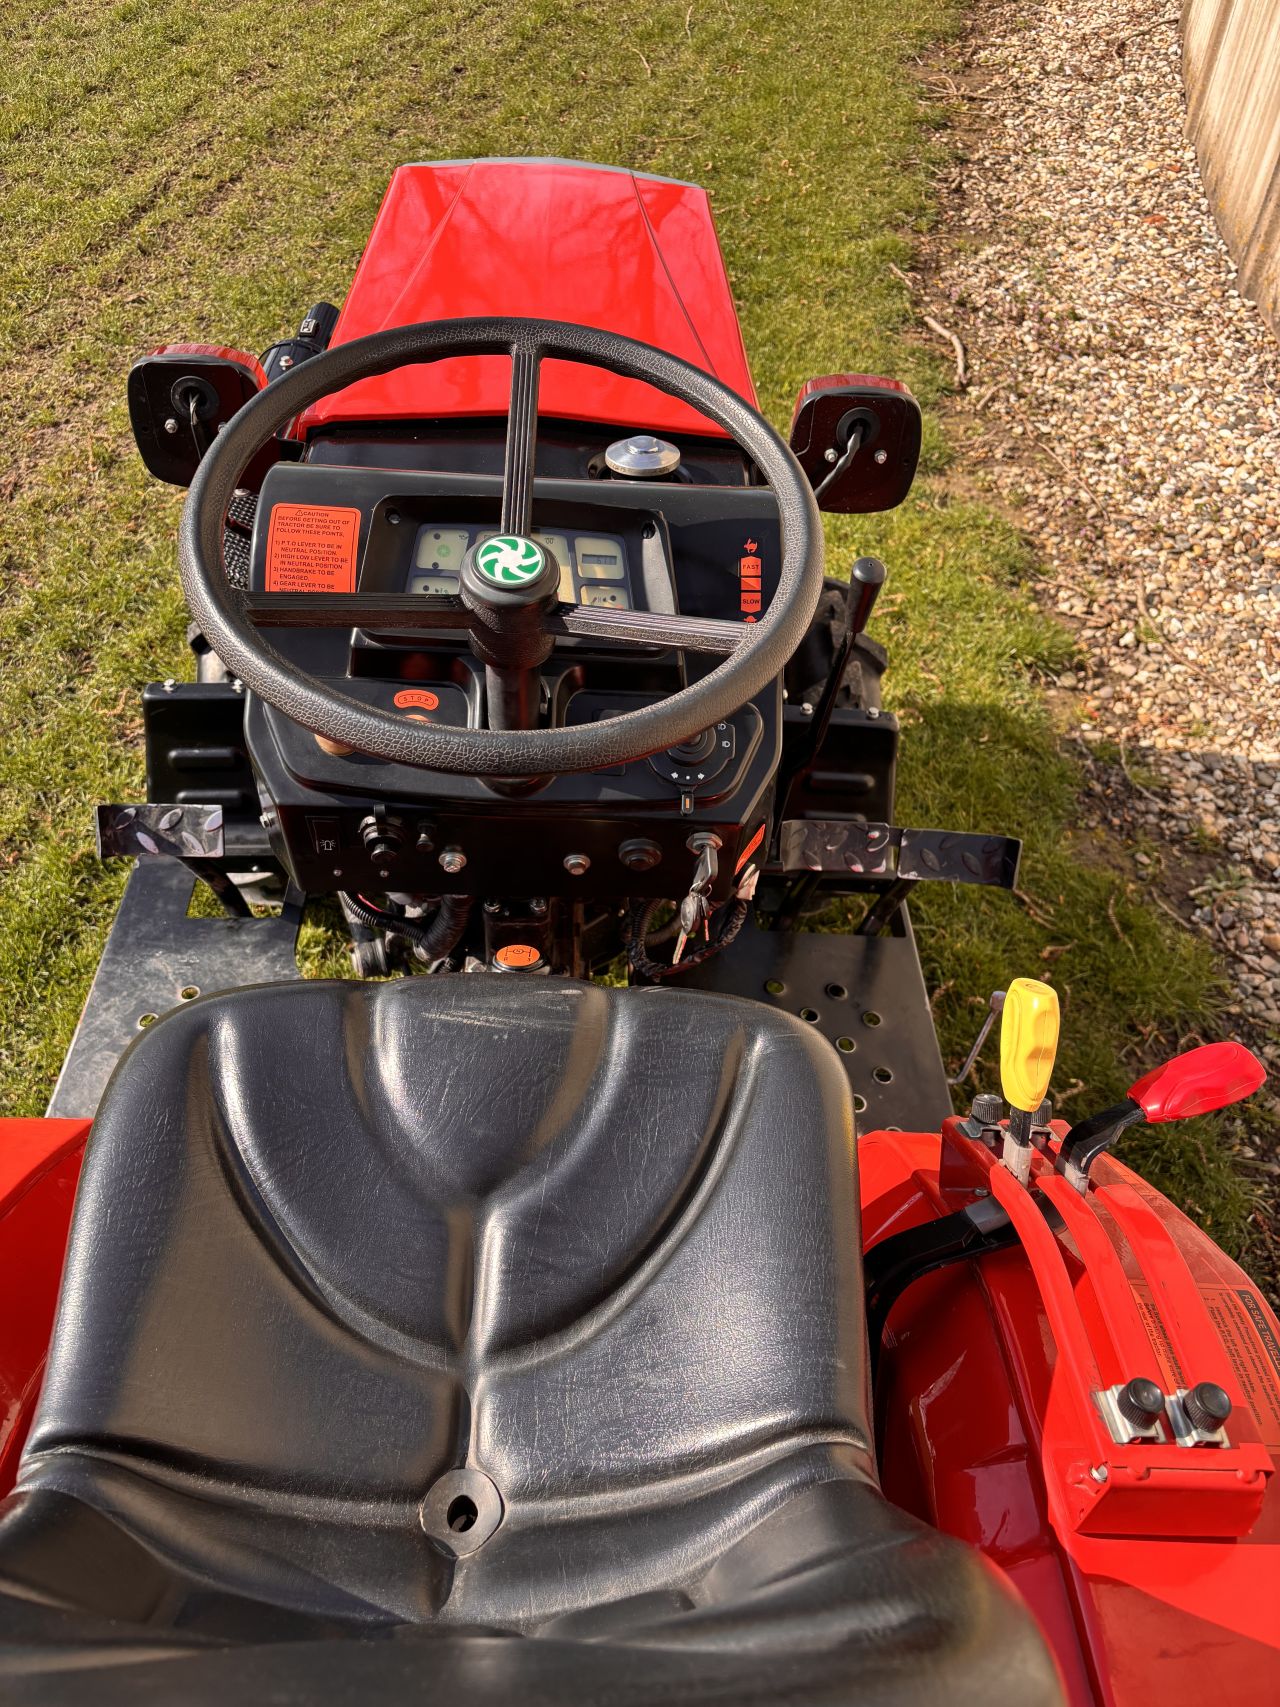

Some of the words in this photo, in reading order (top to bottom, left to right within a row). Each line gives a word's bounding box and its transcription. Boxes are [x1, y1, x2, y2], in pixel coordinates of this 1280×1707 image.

[279, 567, 317, 575] HANDBRAKE
[1242, 1294, 1256, 1309] FOR
[1251, 1310, 1267, 1328] SAFE
